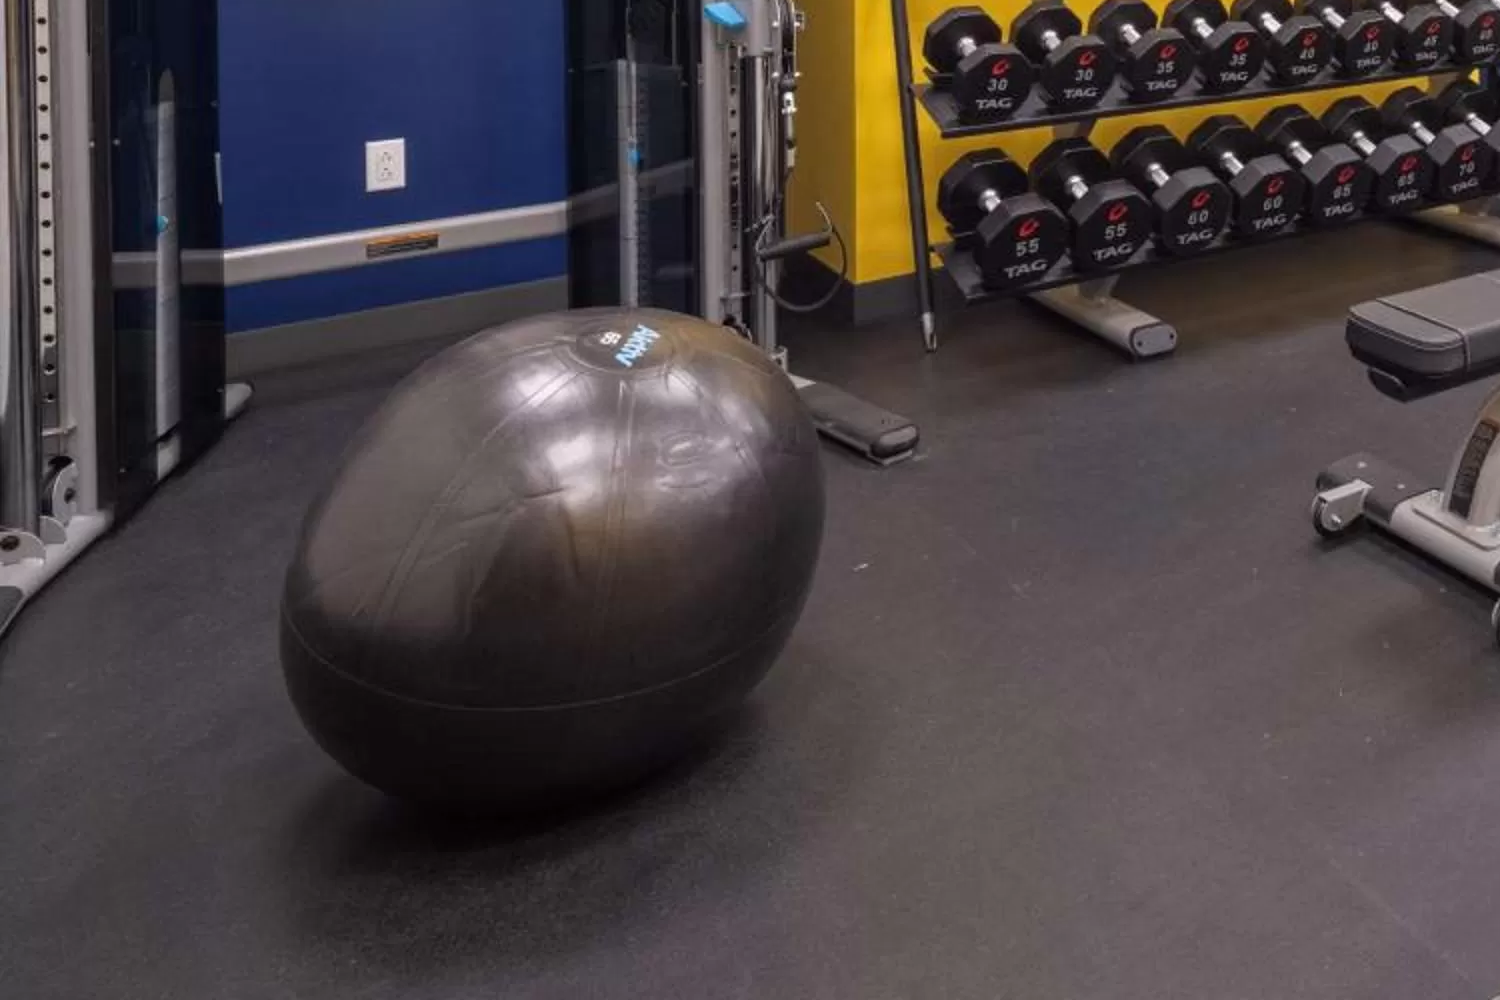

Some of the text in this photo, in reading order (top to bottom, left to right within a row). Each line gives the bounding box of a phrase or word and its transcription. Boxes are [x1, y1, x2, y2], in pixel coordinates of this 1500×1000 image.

[1229, 54, 1247, 66] 35
[1356, 55, 1381, 67] TAG
[1156, 61, 1175, 74] 35
[1292, 64, 1317, 75] TAG
[1075, 69, 1093, 81] 30
[1220, 71, 1248, 81] TAG
[987, 78, 1008, 91] 30
[1148, 79, 1177, 92] TAG
[1063, 87, 1098, 99] TAG
[975, 97, 1013, 110] TAG
[1459, 162, 1475, 176] 70
[1333, 184, 1352, 198] 65
[1451, 178, 1479, 193] TAG
[1263, 195, 1283, 211] 60
[1388, 189, 1418, 204] TAG
[1323, 202, 1354, 217] TAG
[1188, 210, 1209, 225] 60
[1252, 213, 1288, 230] TAG
[1104, 223, 1127, 239] 55
[1176, 228, 1212, 245] TAG
[1016, 238, 1040, 257] 55
[1093, 242, 1133, 261] TAG
[1003, 259, 1048, 278] TAG
